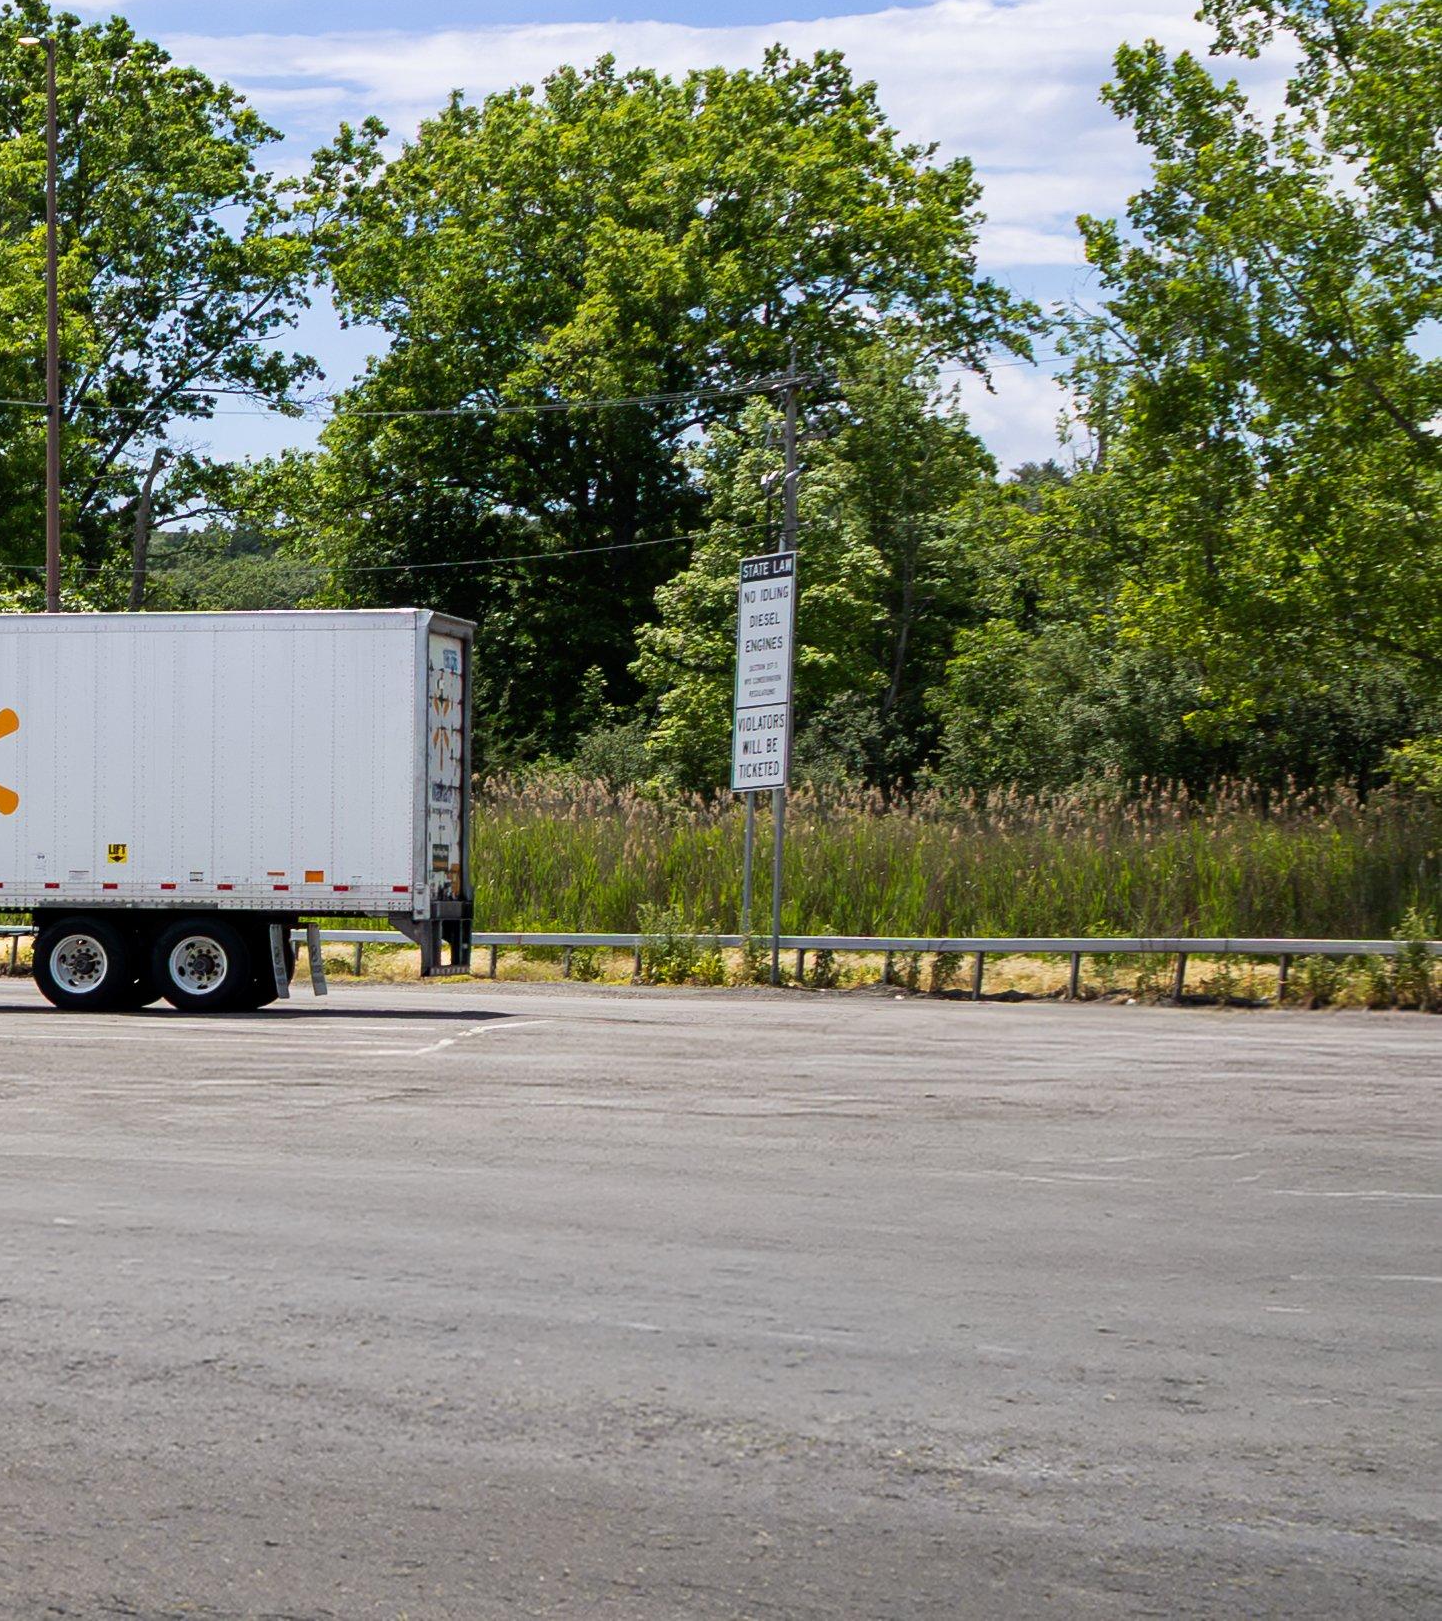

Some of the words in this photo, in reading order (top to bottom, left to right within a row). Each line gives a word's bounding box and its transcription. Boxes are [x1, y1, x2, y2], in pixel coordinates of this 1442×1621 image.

[743, 561, 769, 578] STATE
[773, 558, 792, 574] LAW
[744, 590, 756, 604] NO
[760, 585, 789, 602] IDLING
[749, 611, 781, 628] DIESEL
[745, 636, 783, 653] ENGINES
[737, 714, 784, 732] VIOLATORS
[743, 739, 762, 755] WILL
[766, 738, 778, 753] BE
[739, 761, 779, 778] TICKETED
